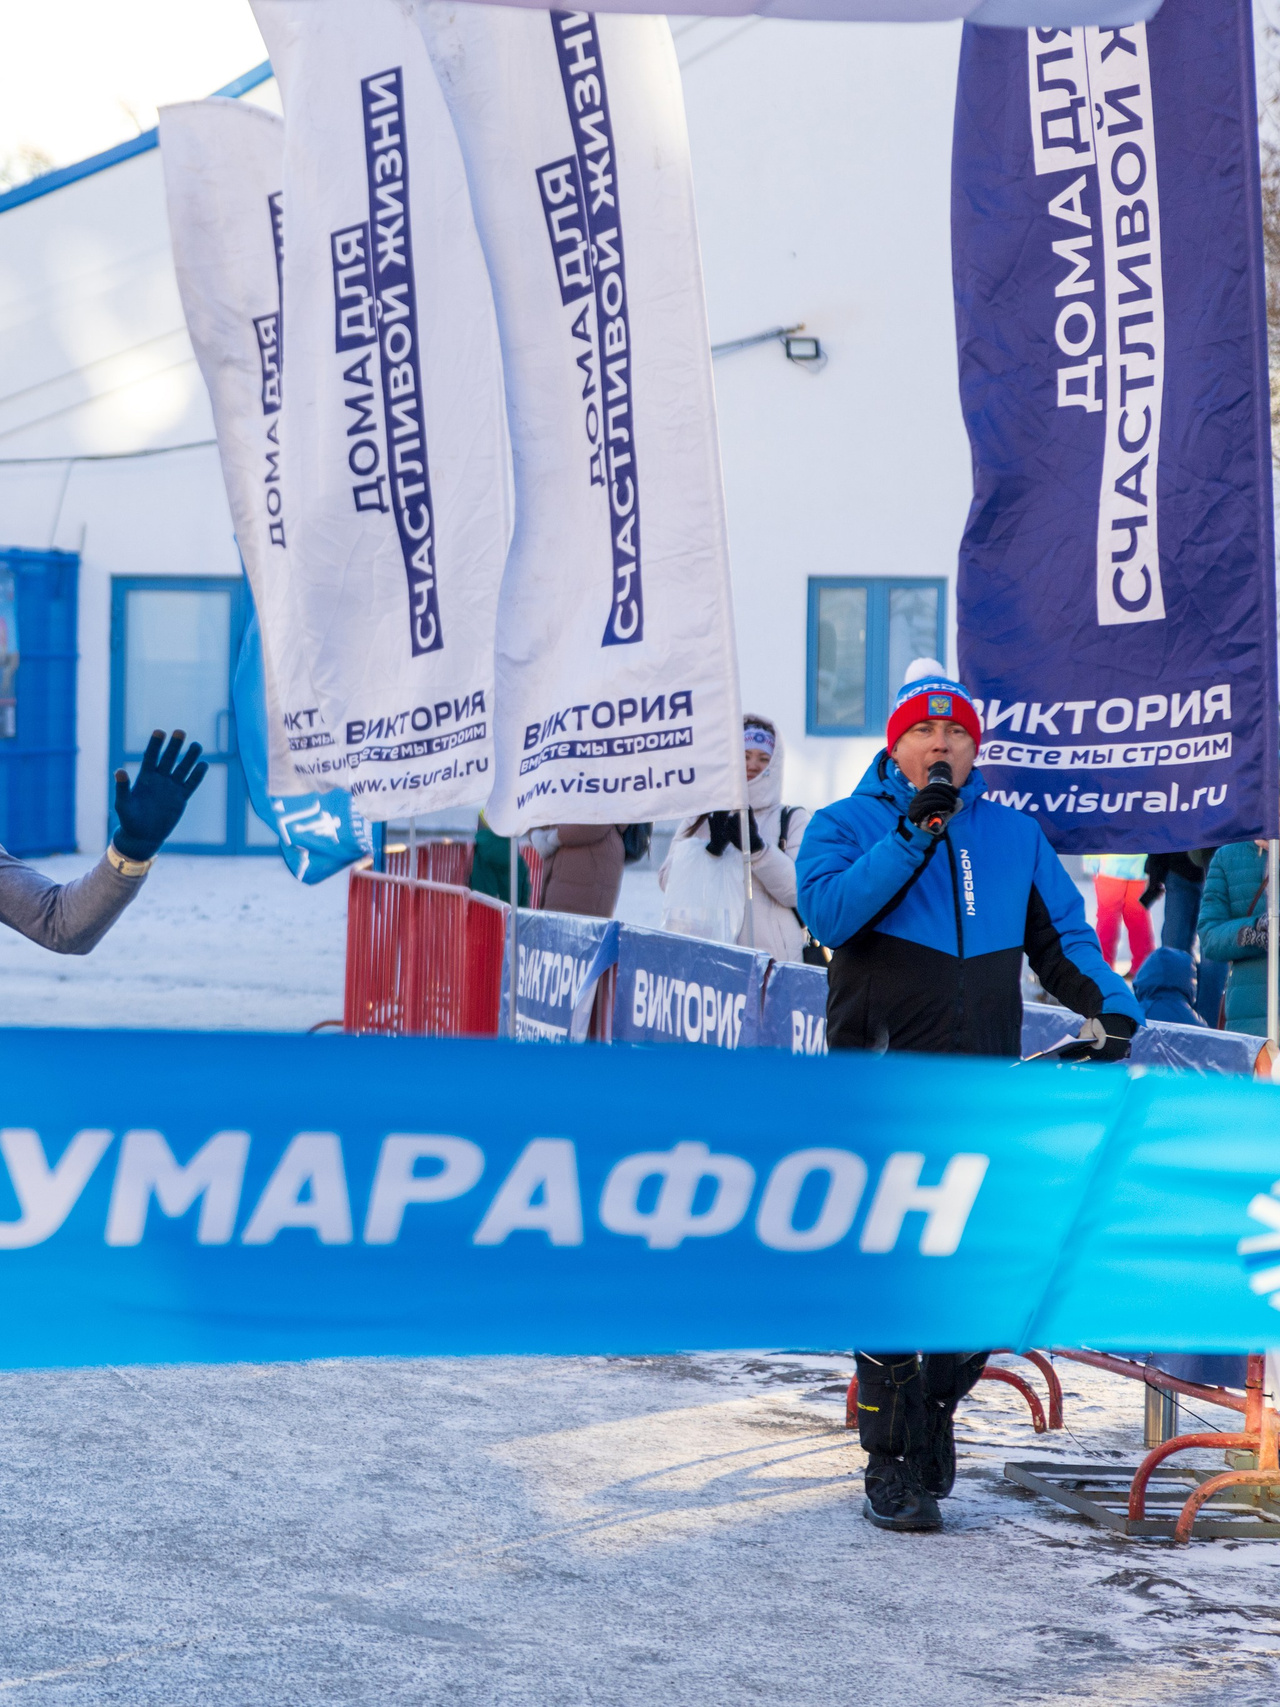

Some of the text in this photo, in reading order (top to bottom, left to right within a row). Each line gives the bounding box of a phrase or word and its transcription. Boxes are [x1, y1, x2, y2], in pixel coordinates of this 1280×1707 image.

[336, 227, 390, 514] ДОМА ДЛЯ
[367, 72, 437, 649] СЧАСТЛИВОЙ ЖИЗНИ
[541, 162, 607, 487] ДОМА ДЛЯ
[1048, 174, 1104, 413] ДОМА
[1096, 84, 1157, 614] СЧАСТЛИВОЙ
[257, 315, 287, 549] ДОМА ДЛЯ
[589, 227, 641, 640] СЧАСТЛИВОЙ
[346, 690, 486, 745] ВИКТОРИЯ
[432, 724, 485, 751] строим
[523, 690, 694, 750] ВИКТОРИЯ
[576, 742, 608, 756] мы
[613, 729, 691, 754] строим
[1070, 747, 1113, 765] мы
[1122, 737, 1229, 765] строим
[960, 848, 976, 916] NORDSKI
[633, 968, 747, 1050] ВИКТОРИЯ
